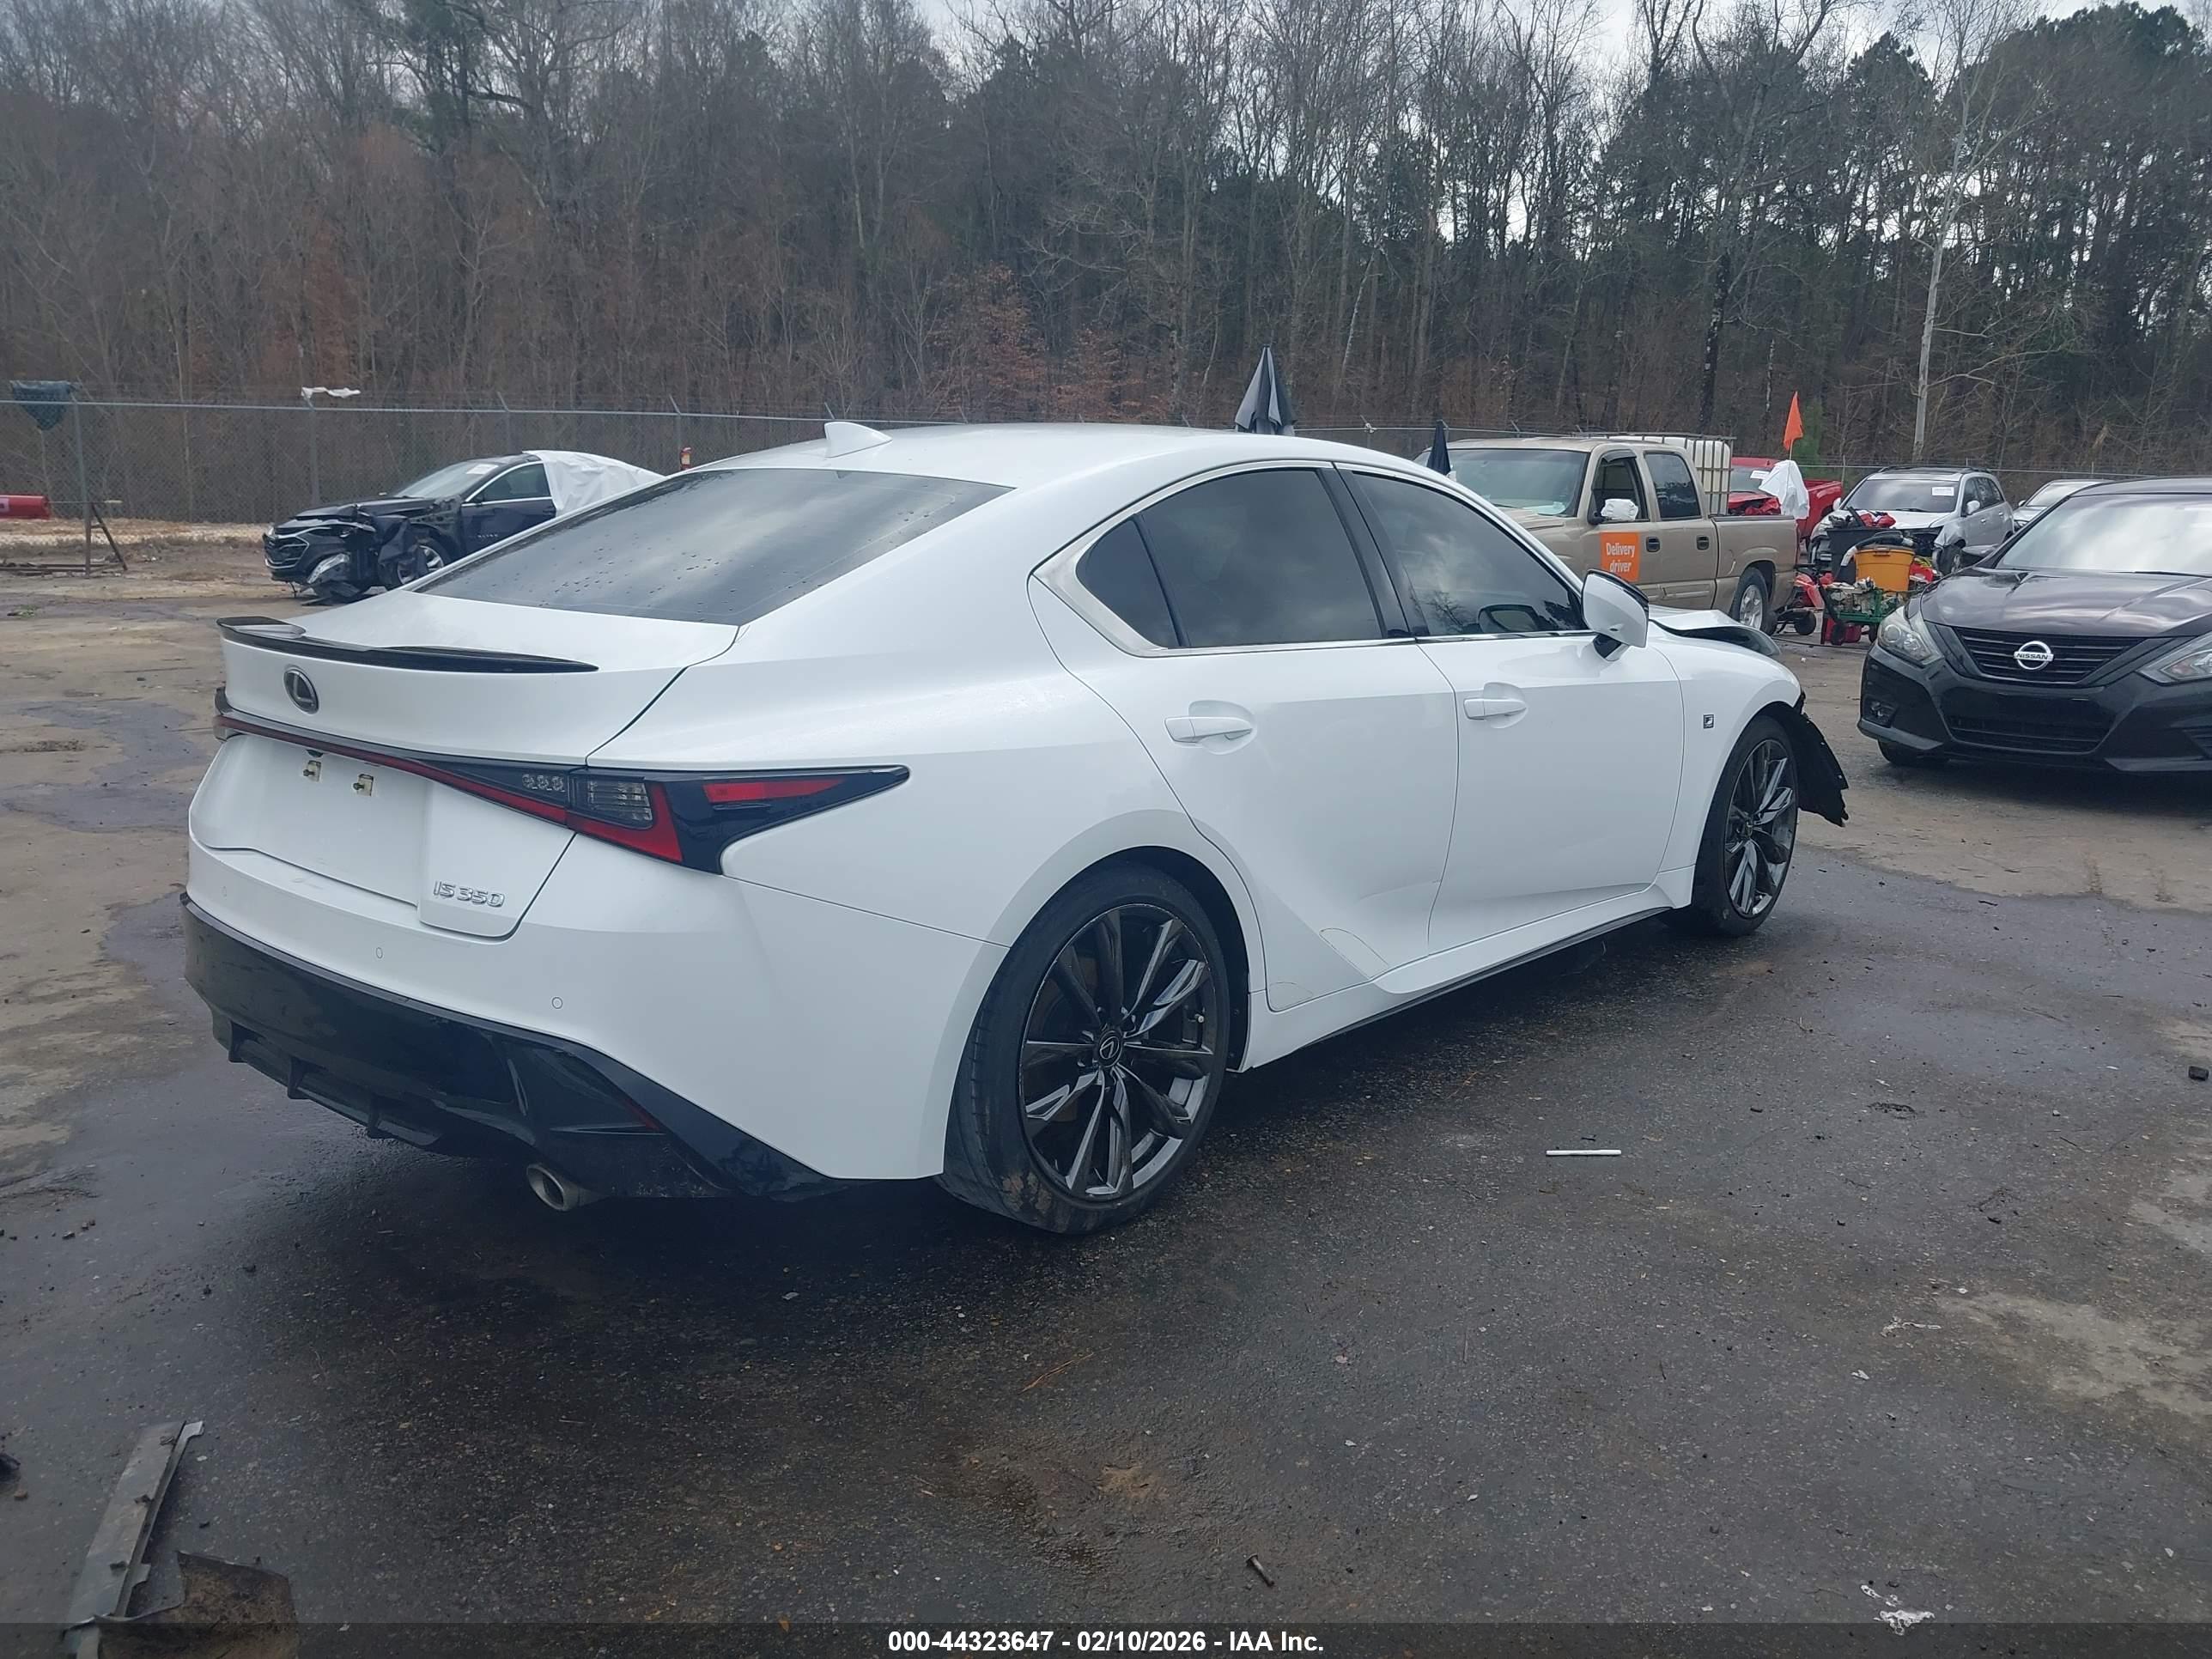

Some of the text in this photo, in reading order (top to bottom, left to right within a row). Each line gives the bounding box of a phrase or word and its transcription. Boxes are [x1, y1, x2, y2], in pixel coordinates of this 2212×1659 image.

[1606, 542, 1635, 558] Delivery
[1610, 559, 1632, 574] driver
[433, 881, 506, 908] IS 350
